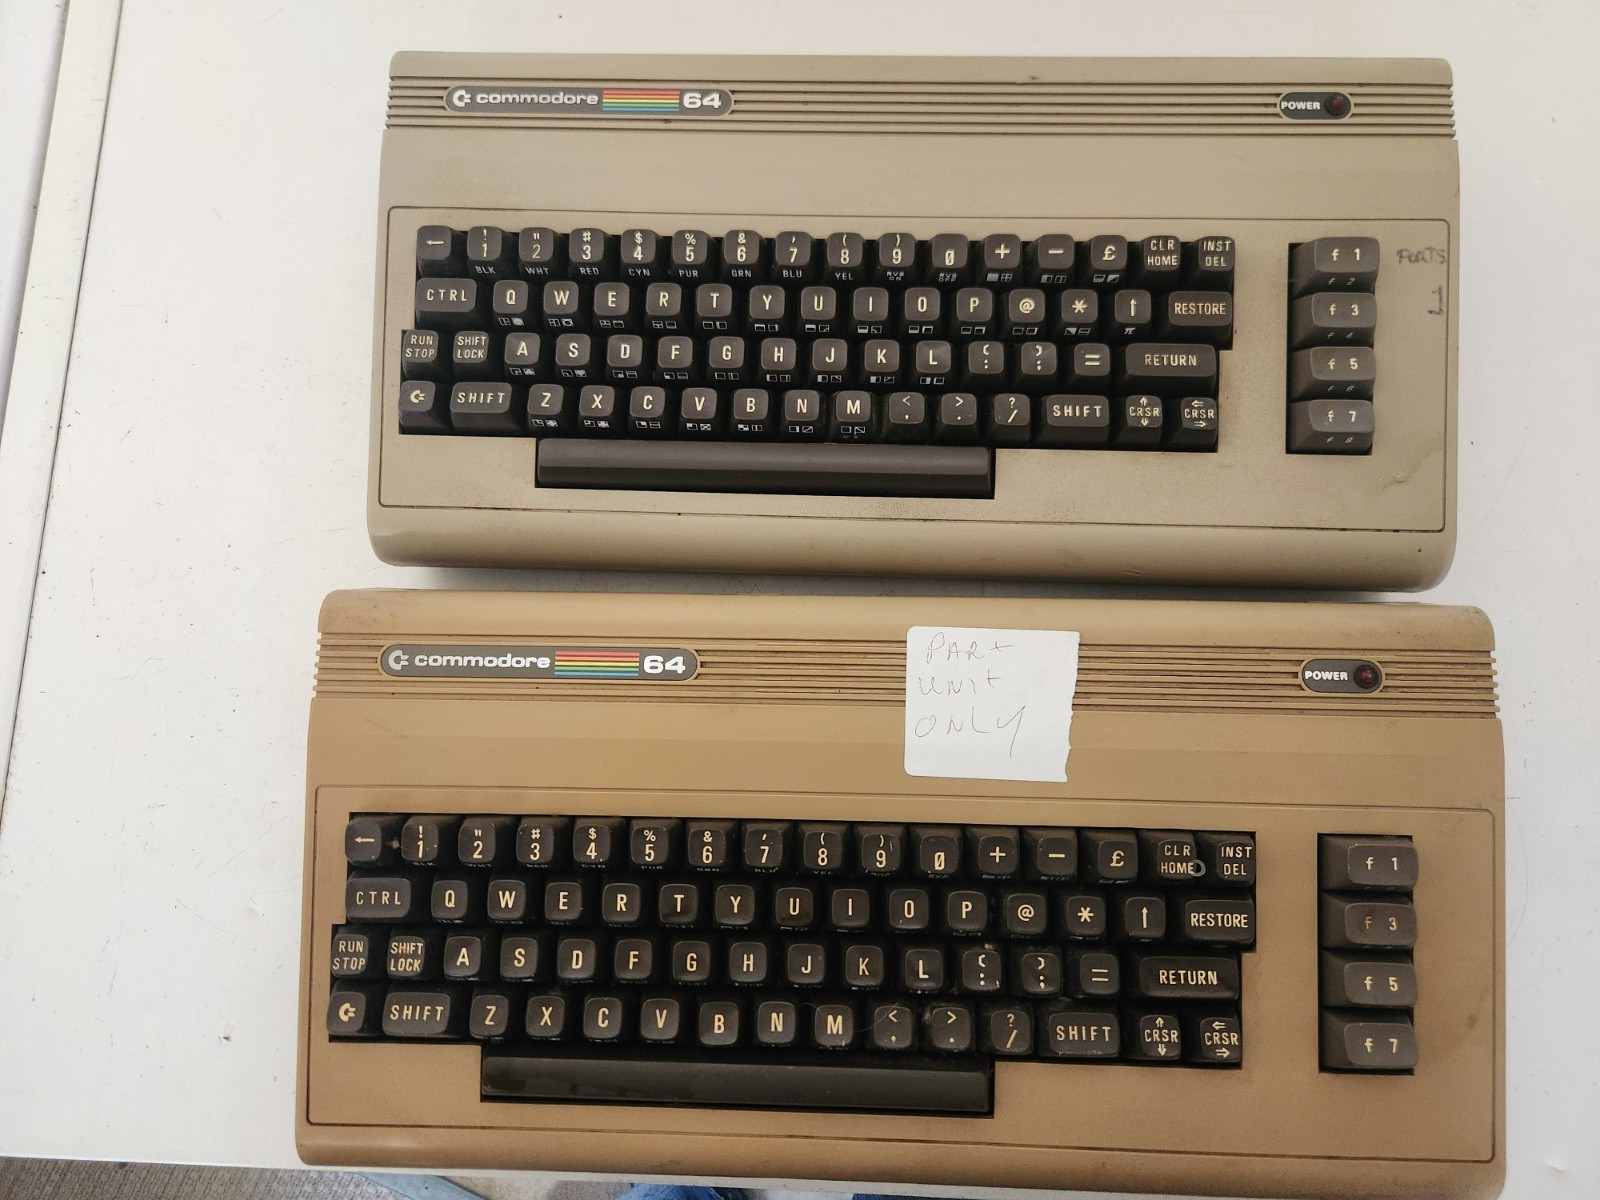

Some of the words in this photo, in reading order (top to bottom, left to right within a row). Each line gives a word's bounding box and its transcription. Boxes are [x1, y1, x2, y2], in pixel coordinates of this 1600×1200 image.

[476, 92, 598, 105] commodore
[683, 92, 722, 109] 64
[1281, 101, 1320, 109] POWER
[482, 245, 487, 257] 1
[532, 245, 541, 259] 2
[582, 246, 591, 259] 3
[1150, 240, 1174, 250] CLR
[1203, 240, 1232, 251] INST
[633, 246, 643, 260] 4
[685, 247, 694, 261] 5
[737, 247, 746, 261] 6
[790, 249, 798, 263] 7
[840, 249, 849, 264] 8
[892, 249, 901, 264] 9
[1147, 255, 1178, 266] HOME
[1205, 256, 1227, 266] DEL
[476, 266, 496, 274] BLK
[525, 267, 549, 275] WHT
[580, 267, 599, 275] RED
[628, 268, 650, 276] CYN
[679, 270, 698, 278] PUR
[731, 269, 751, 278] GRN
[783, 270, 802, 278] BLU
[835, 272, 854, 280] YEL
[426, 290, 467, 302] CTRL
[506, 290, 516, 305] Q
[554, 290, 569, 305] W
[607, 292, 616, 307] E
[660, 292, 668, 307] R
[710, 293, 720, 308] T
[762, 294, 772, 310] Y
[814, 295, 823, 310] U
[969, 297, 979, 312] P
[1174, 303, 1226, 315] RESTORE
[411, 335, 433, 345] RUN
[457, 336, 487, 346] SHIFT
[405, 348, 435, 358] STOP
[457, 349, 485, 359] LOCK
[517, 341, 528, 356] A
[569, 343, 579, 357] S
[621, 344, 630, 359] D
[671, 345, 680, 359] F
[722, 346, 732, 360] G
[774, 347, 784, 362] H
[825, 347, 835, 362] J
[877, 349, 887, 363] K
[929, 350, 937, 365] L
[1144, 354, 1197, 366] RETURN
[457, 392, 505, 404] SHIFT
[541, 393, 551, 407] Z
[592, 394, 602, 409] X
[643, 395, 652, 410] C
[695, 397, 705, 411] V
[746, 398, 755, 412] B
[797, 399, 807, 413] N
[847, 400, 861, 415] M
[1053, 405, 1102, 416] SHIFT
[1129, 407, 1160, 417] CRSR
[1184, 408, 1215, 419] CRSR
[414, 653, 551, 669] commodore
[643, 655, 686, 674] 64
[1305, 670, 1348, 680] POWER
[914, 704, 1026, 758] ONLY
[417, 841, 423, 858] 1
[473, 841, 482, 859] 2
[530, 842, 540, 860] 3
[586, 842, 597, 859] 4
[645, 844, 655, 861] 5
[702, 846, 712, 863] 6
[760, 846, 770, 863] 7
[817, 848, 828, 865] 8
[1164, 845, 1191, 856] CLR
[1221, 846, 1253, 858] INST
[876, 850, 886, 868] 9
[1160, 862, 1194, 873] HOME
[1223, 863, 1247, 875] DEL
[356, 891, 401, 905] CTRL
[445, 890, 455, 908] Q
[498, 890, 515, 908] W
[559, 891, 569, 909] E
[616, 894, 626, 912] R
[674, 894, 684, 912] T
[730, 895, 742, 913] Y
[789, 898, 800, 915] U
[961, 901, 972, 918] P
[1190, 912, 1249, 928] RESTORE
[339, 941, 364, 952] RUN
[391, 942, 423, 954] SHIFT
[332, 958, 366, 970] STOP
[456, 948, 469, 966] A
[513, 948, 526, 967] S
[572, 950, 583, 969] D
[629, 951, 639, 969] F
[686, 953, 697, 971] G
[743, 954, 754, 971] H
[801, 955, 812, 973] J
[390, 958, 421, 972] LOCK
[859, 957, 869, 975] K
[918, 960, 929, 978] L
[1159, 970, 1218, 985] RETURN
[390, 1004, 444, 1021] SHIFT
[485, 1006, 497, 1025] Z
[540, 1007, 553, 1026] X
[598, 1007, 609, 1027] C
[655, 1009, 667, 1028] V
[714, 1014, 724, 1033] B
[771, 1013, 783, 1032] N
[827, 1015, 843, 1034] M
[1056, 1025, 1111, 1042] SHIFT
[1144, 1029, 1178, 1043] CRSR
[1204, 1032, 1239, 1046] CRSR
